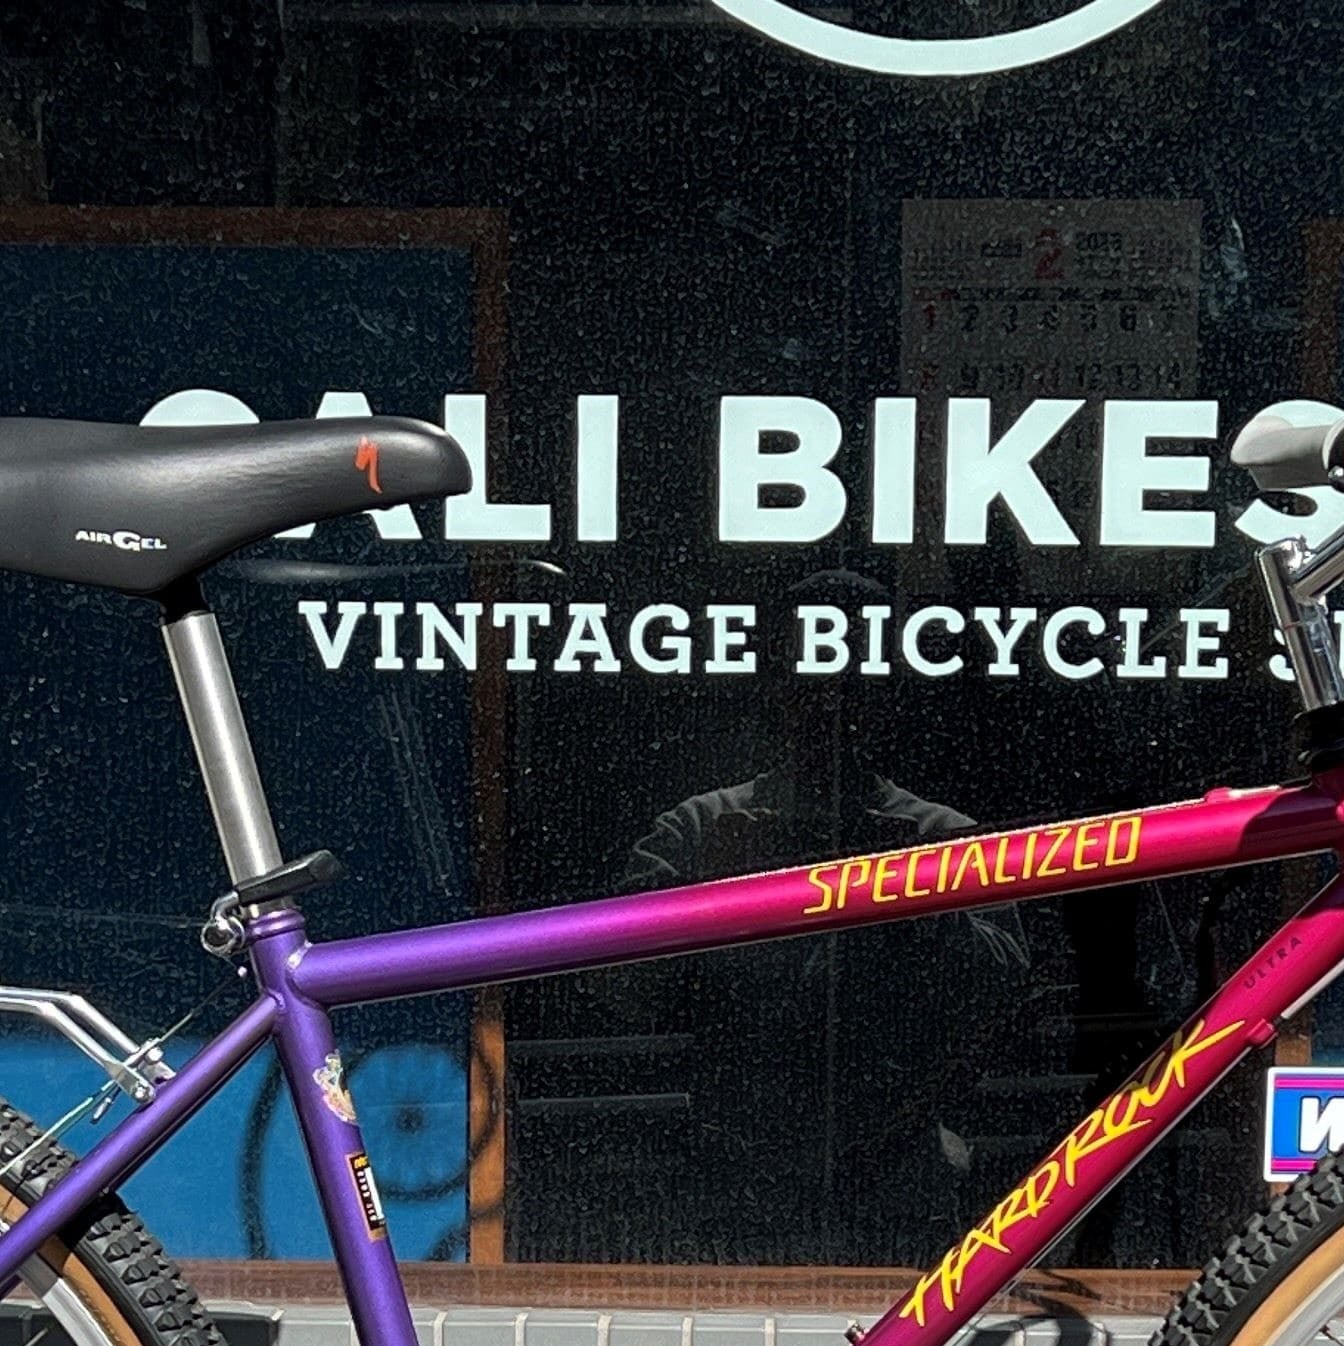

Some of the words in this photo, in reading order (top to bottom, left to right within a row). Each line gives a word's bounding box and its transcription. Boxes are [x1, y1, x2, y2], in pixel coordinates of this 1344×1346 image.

[298, 601, 757, 675] VINTAGE
[796, 605, 1230, 679] BICYCLE
[804, 817, 1142, 914] SPECIALIZED
[1243, 936, 1302, 989] ULTRA
